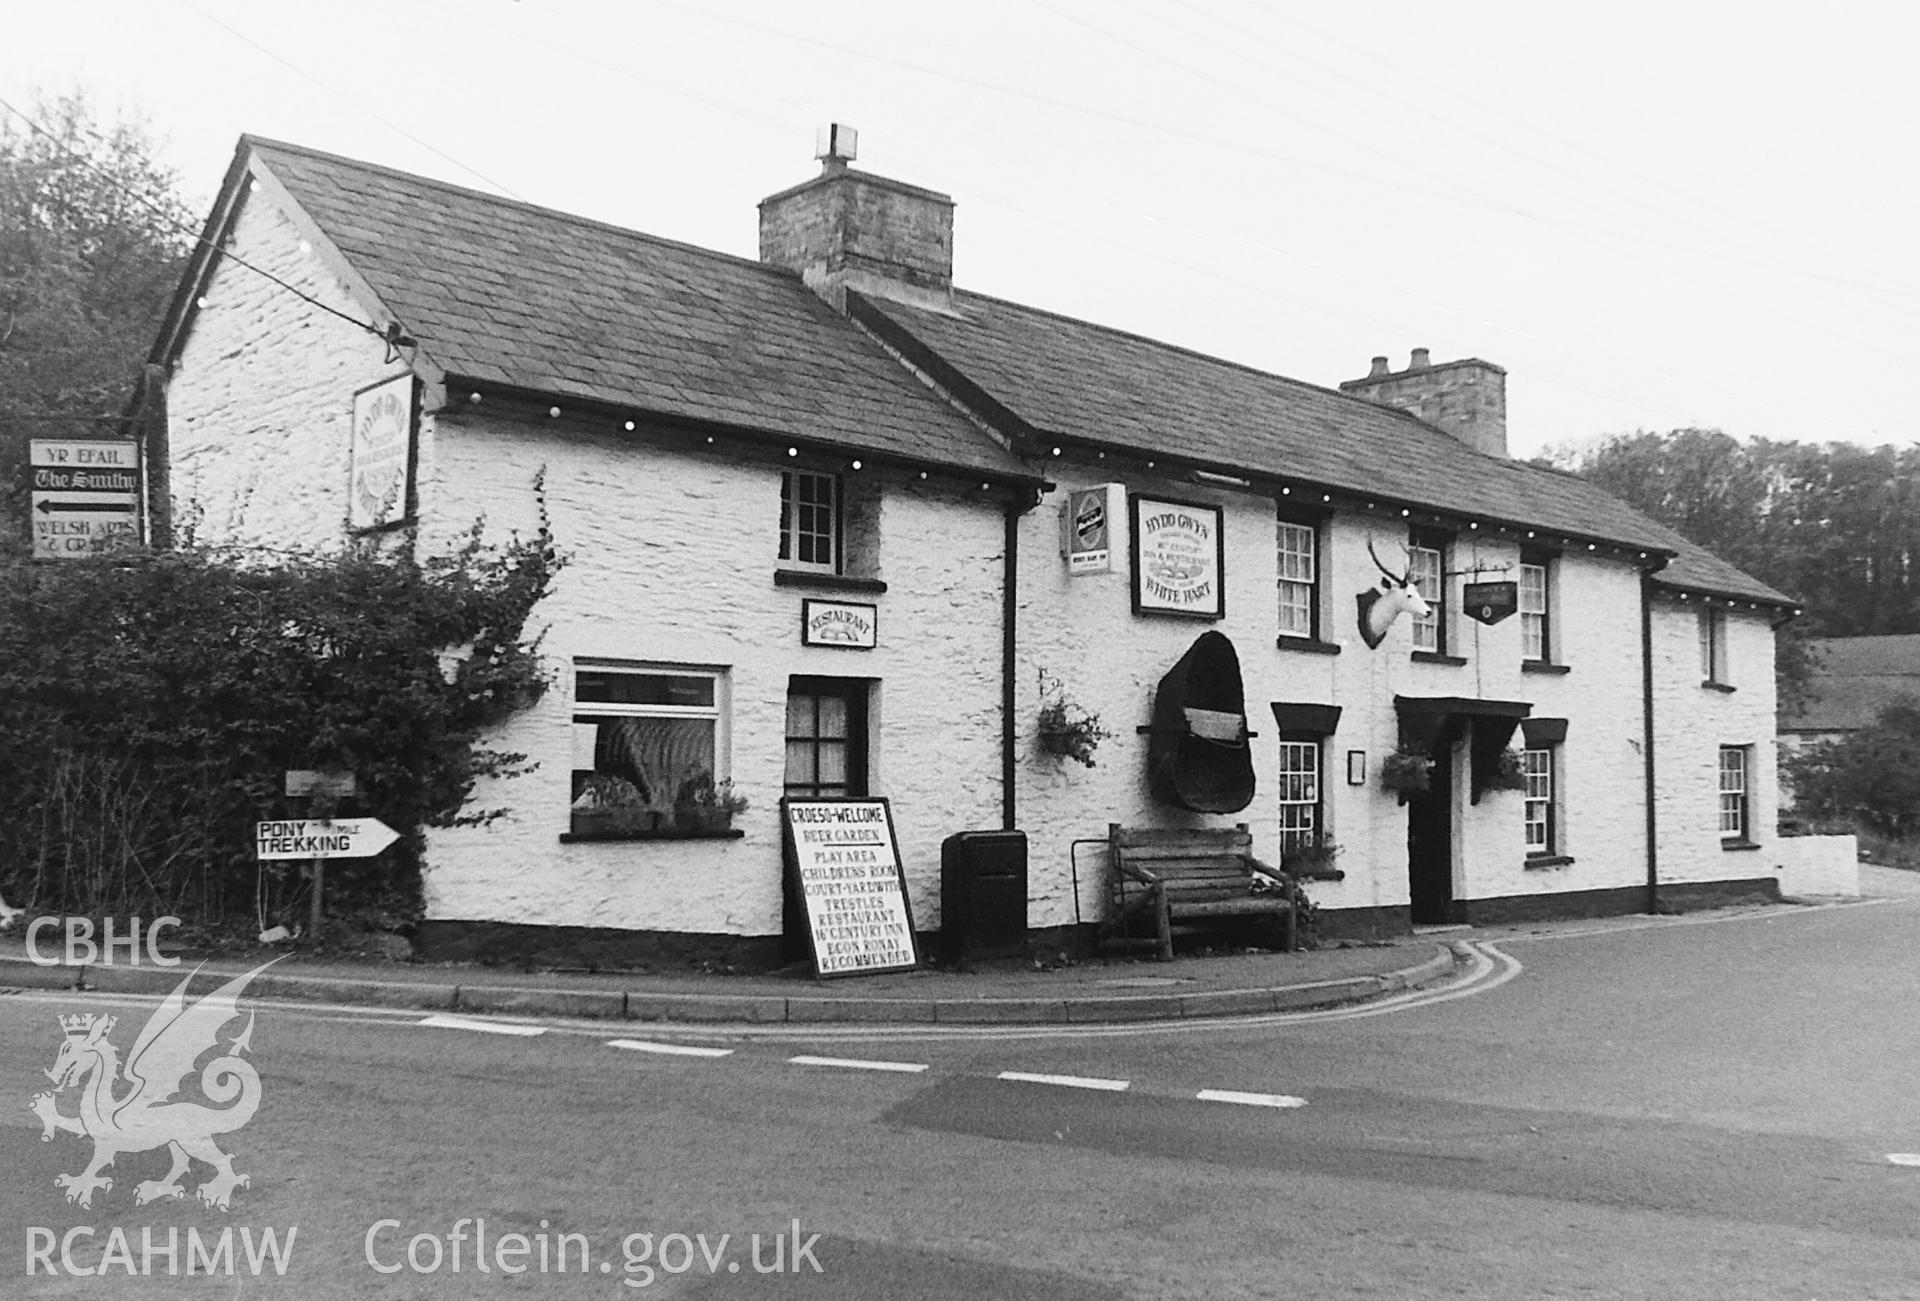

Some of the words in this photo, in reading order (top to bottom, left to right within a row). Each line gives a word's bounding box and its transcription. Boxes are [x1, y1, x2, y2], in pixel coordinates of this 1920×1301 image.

[47, 448, 68, 462] YR
[78, 449, 124, 464] EFAIL
[35, 470, 69, 488] The
[71, 472, 137, 493] Smithy
[38, 521, 90, 535] WELSH
[1146, 513, 1176, 534] HYDD
[1178, 513, 1208, 539] GWYN
[1146, 576, 1180, 603] WHITE
[1183, 581, 1211, 603] HART
[810, 610, 872, 634] RESTAURANT
[259, 822, 306, 837] PONY
[803, 829, 833, 843] BEER
[835, 829, 880, 842] GARDEN
[258, 836, 350, 853] TREKKING
[814, 851, 844, 864] PLAY
[846, 850, 877, 862] AREA
[802, 866, 866, 880] CHILDRENS
[824, 896, 885, 912] TRESTLES
[818, 909, 895, 926] RESTAURANT
[830, 924, 882, 940] CENTURY
[863, 938, 900, 954] RONAY
[822, 950, 911, 970] RECOMMENDED
